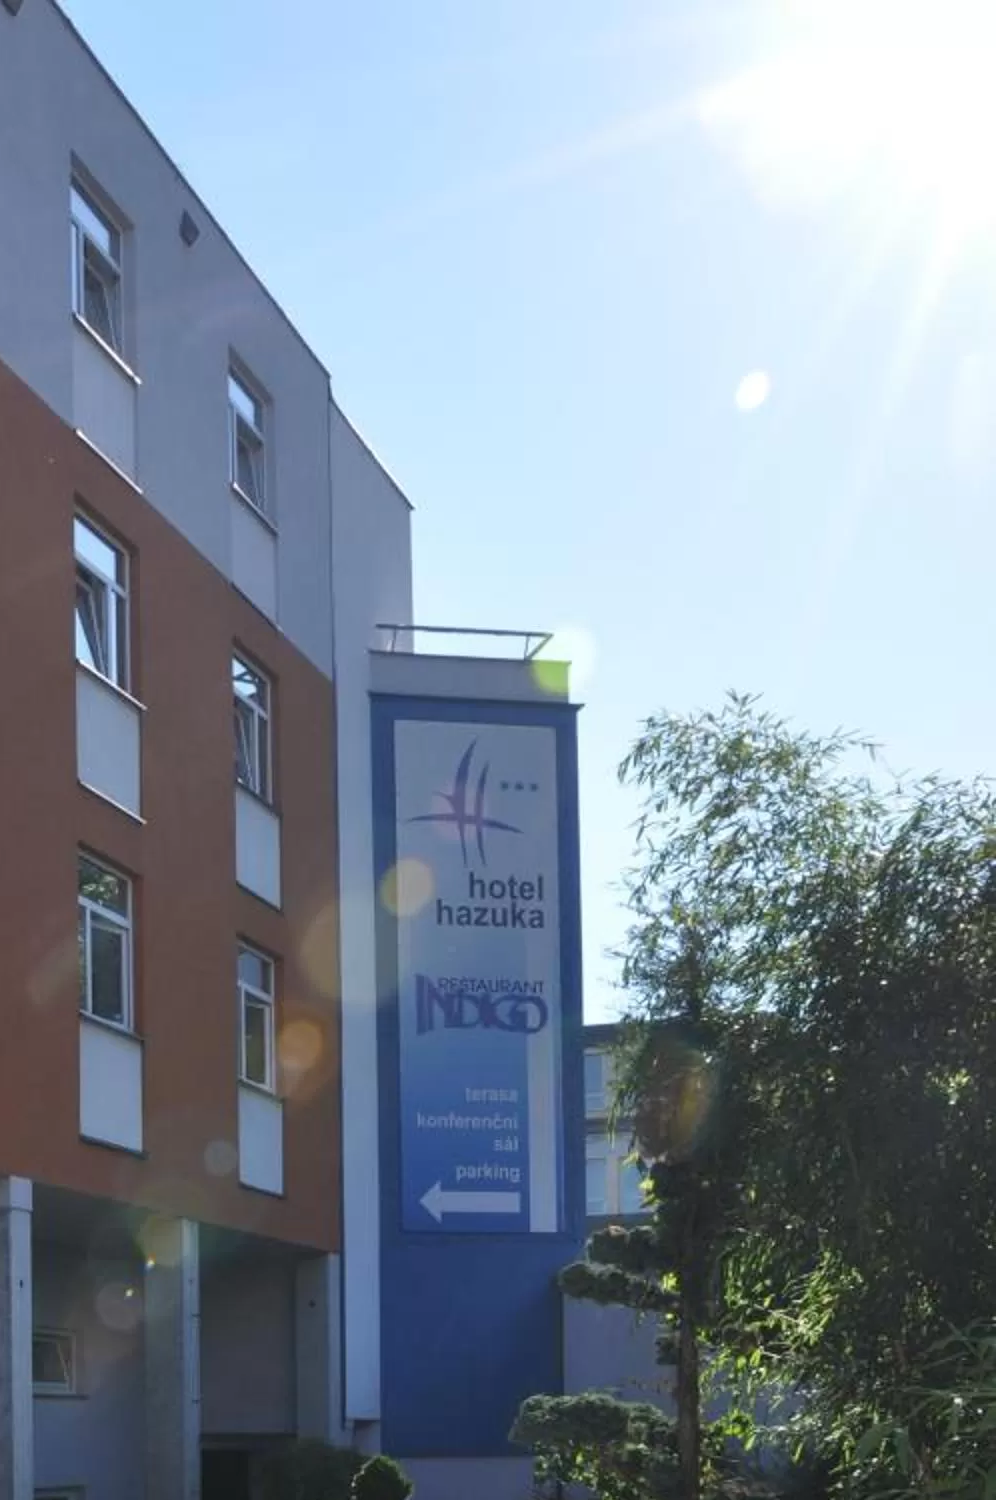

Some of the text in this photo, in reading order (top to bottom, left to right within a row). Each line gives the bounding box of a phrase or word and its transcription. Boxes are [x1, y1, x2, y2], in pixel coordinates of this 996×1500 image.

[468, 870, 545, 901] hotel
[435, 898, 546, 929] hazuka
[438, 976, 545, 994] RESTAURANT
[415, 972, 548, 1036] INDIGO
[465, 1087, 520, 1103] terasa
[493, 1136, 519, 1152] sál
[455, 1162, 521, 1183] parking
